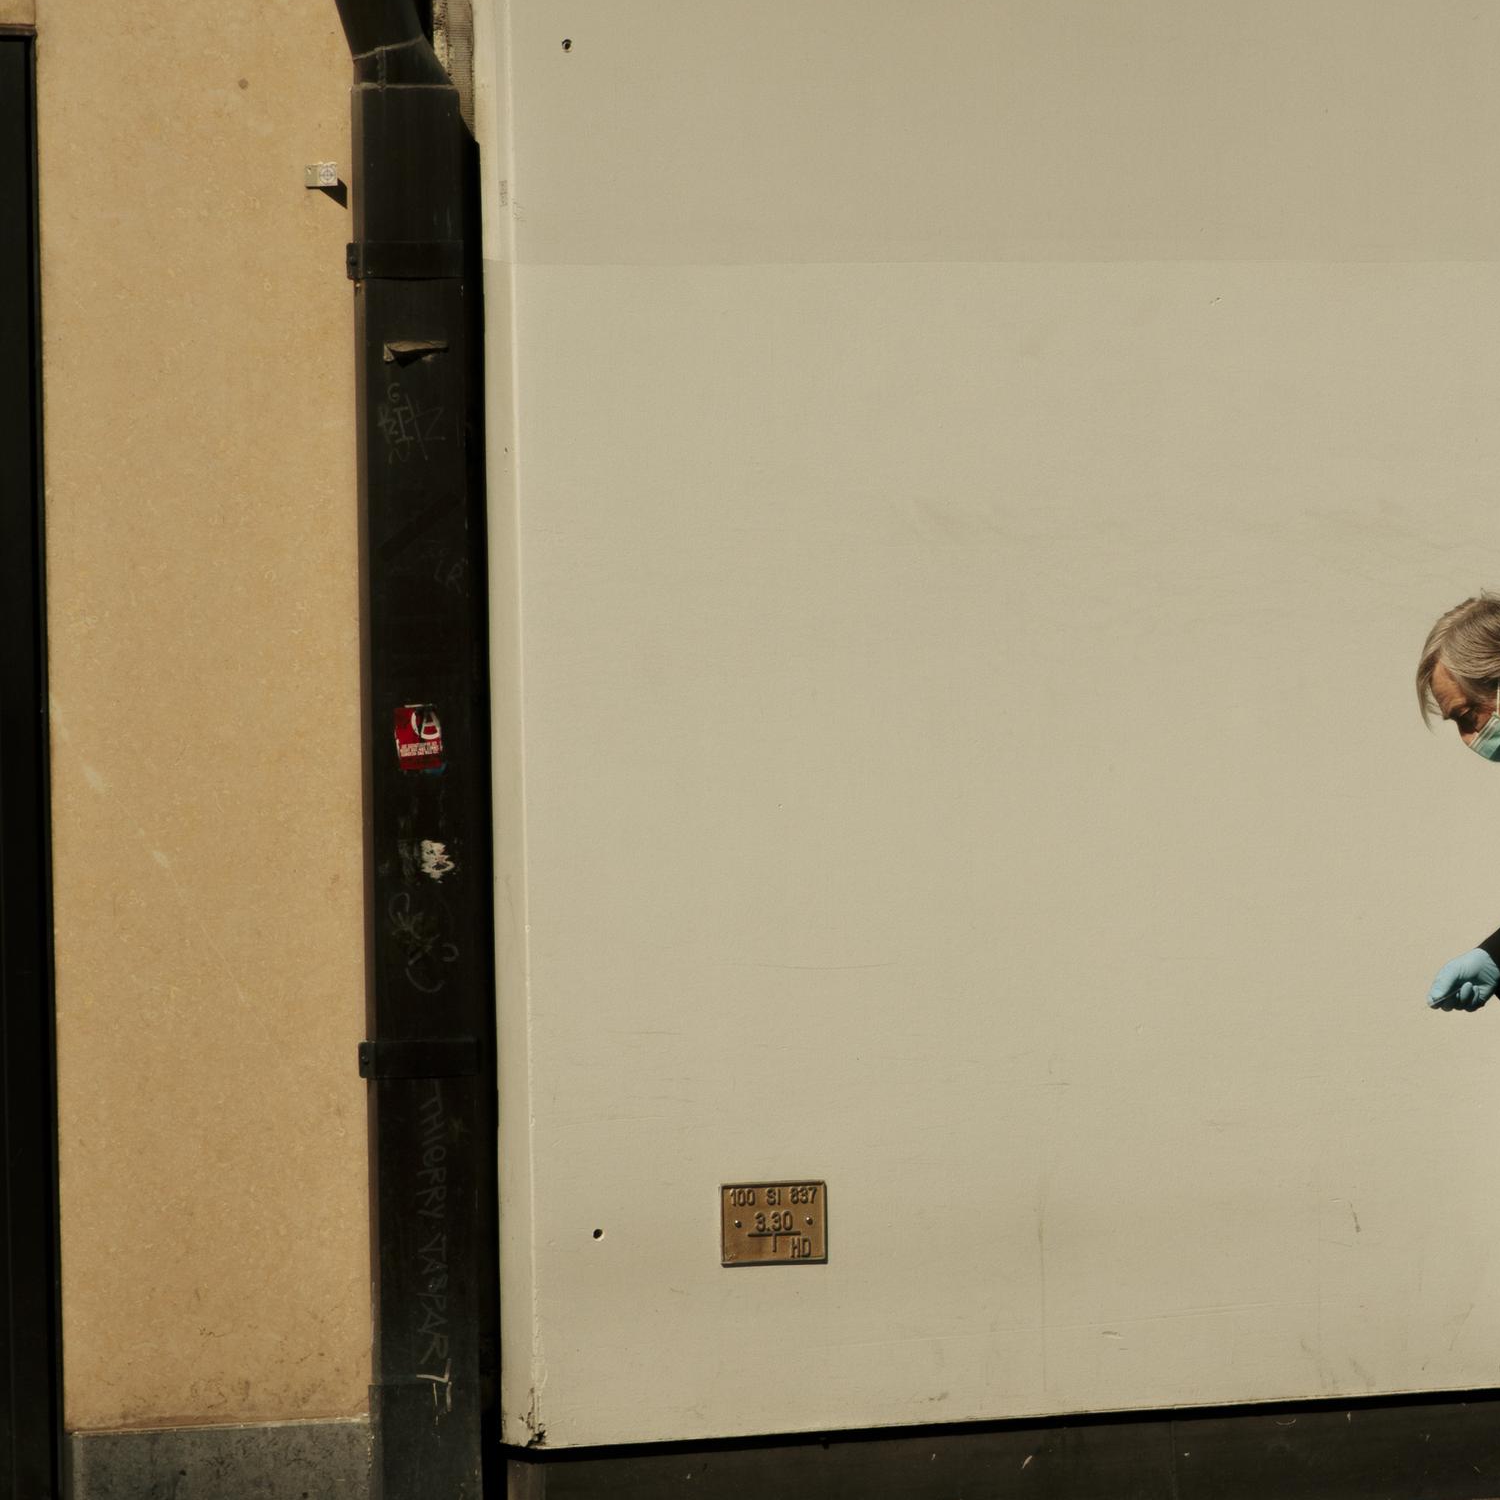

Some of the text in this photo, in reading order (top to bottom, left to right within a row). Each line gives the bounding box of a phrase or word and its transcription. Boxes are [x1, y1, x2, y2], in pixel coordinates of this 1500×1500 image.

[729, 1187, 756, 1207] 100
[754, 1210, 794, 1232] 3.30
[790, 1236, 811, 1258] HD
